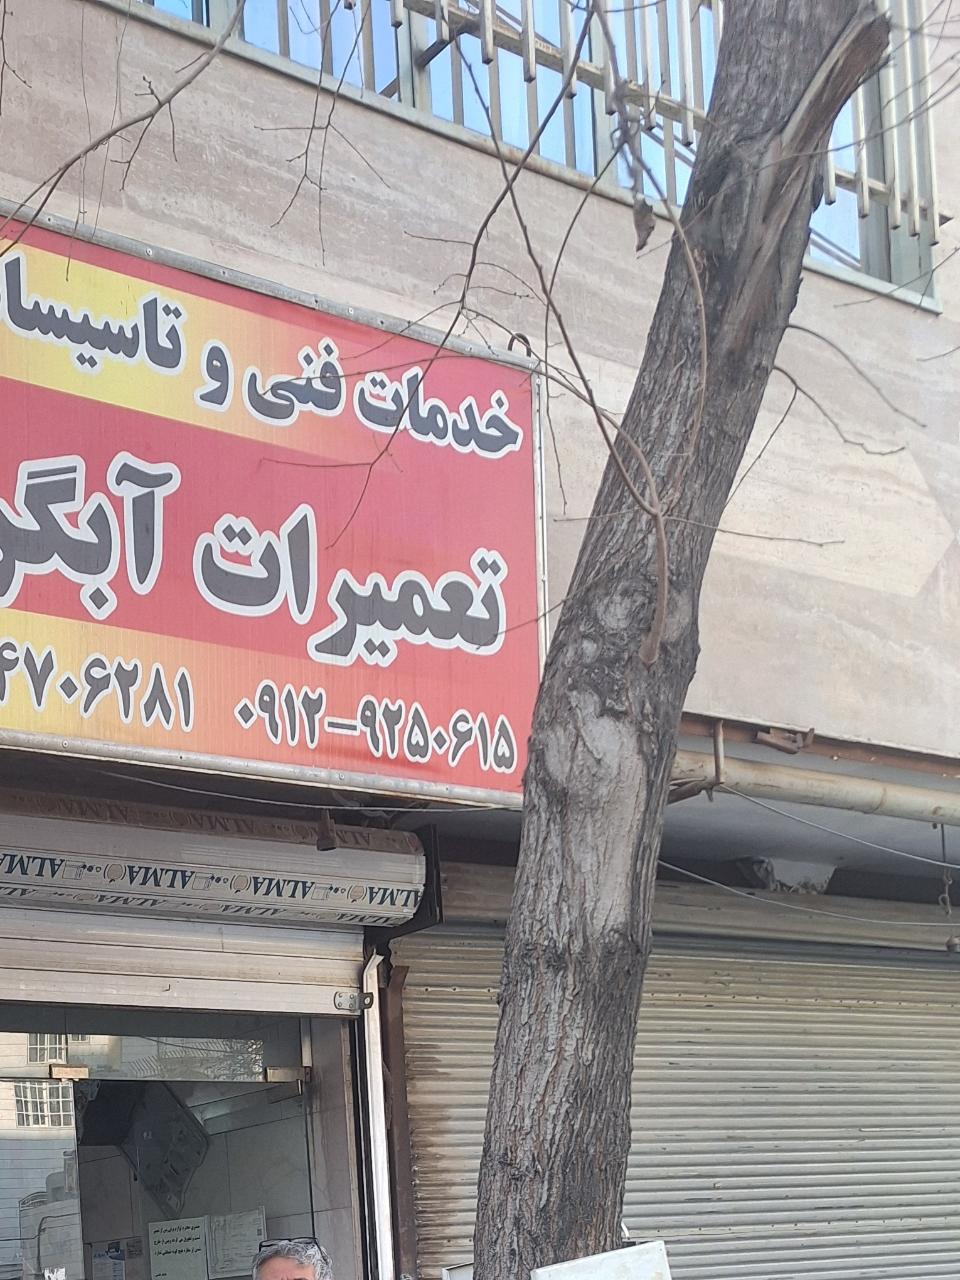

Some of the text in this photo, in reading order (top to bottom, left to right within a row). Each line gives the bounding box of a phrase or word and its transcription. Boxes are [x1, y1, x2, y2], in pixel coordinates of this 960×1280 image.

[198, 345, 230, 405] و
[246, 341, 343, 421] فنی
[356, 371, 520, 455] خدمات
[199, 512, 504, 659] تعمیرات
[126, 864, 196, 890] ALMA
[251, 875, 316, 899] ALMA
